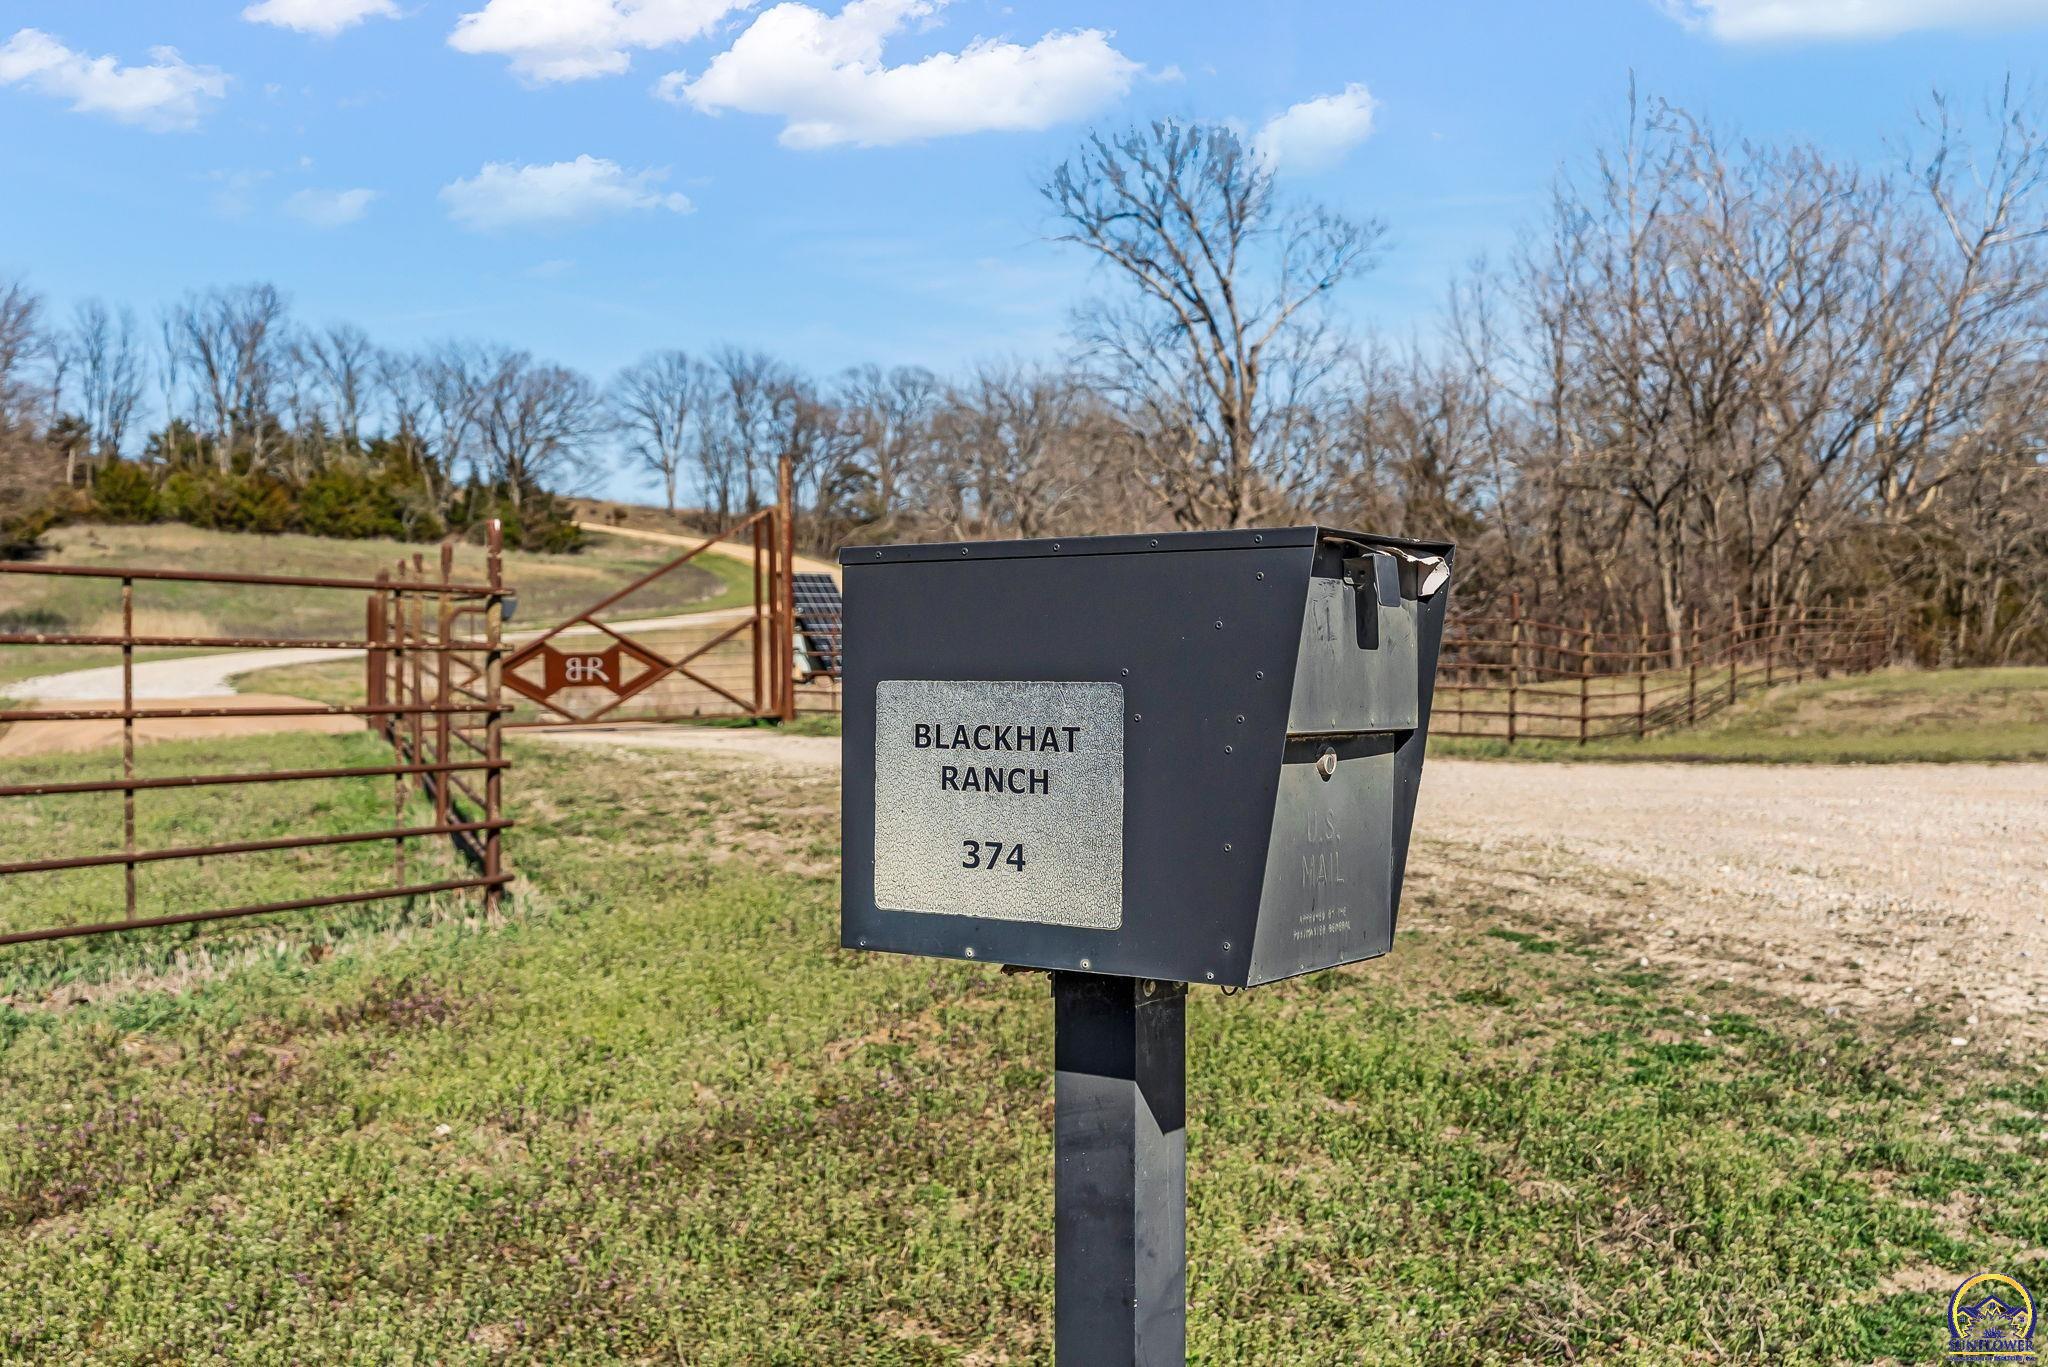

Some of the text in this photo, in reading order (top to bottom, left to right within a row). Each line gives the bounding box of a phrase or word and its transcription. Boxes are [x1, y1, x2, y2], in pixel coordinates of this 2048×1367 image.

[914, 723, 1080, 753] BLACKHAT
[941, 765, 1049, 794] RANCH
[1307, 808, 1341, 842] U.S.
[962, 840, 1026, 872] 374
[1302, 851, 1345, 888] MAIL
